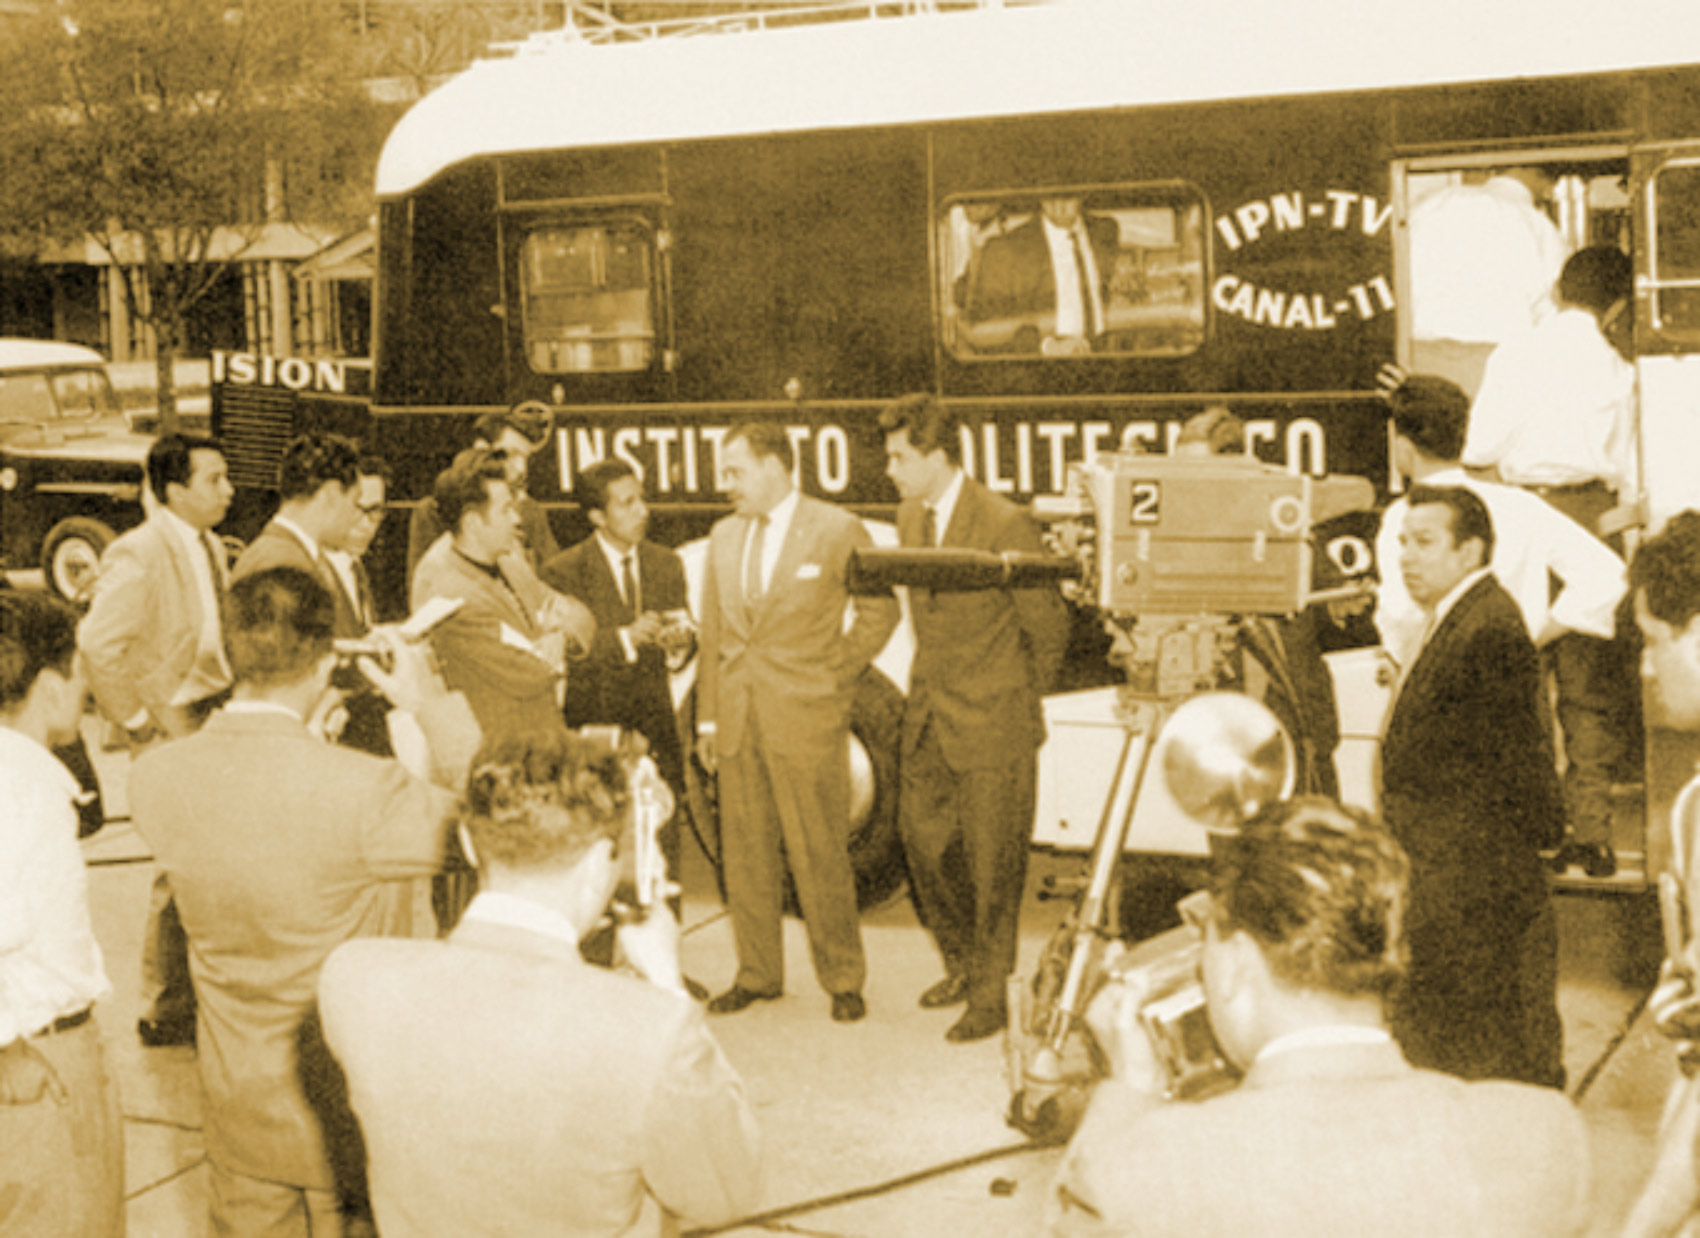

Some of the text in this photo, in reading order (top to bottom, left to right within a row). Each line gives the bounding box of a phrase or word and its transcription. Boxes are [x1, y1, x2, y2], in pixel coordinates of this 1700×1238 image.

[1216, 190, 1392, 250] IPN-TV
[1213, 275, 1396, 329] CANAL-11
[212, 351, 345, 391] ISION
[556, 425, 849, 492] INSTITTO
[1132, 484, 1158, 521] 2
